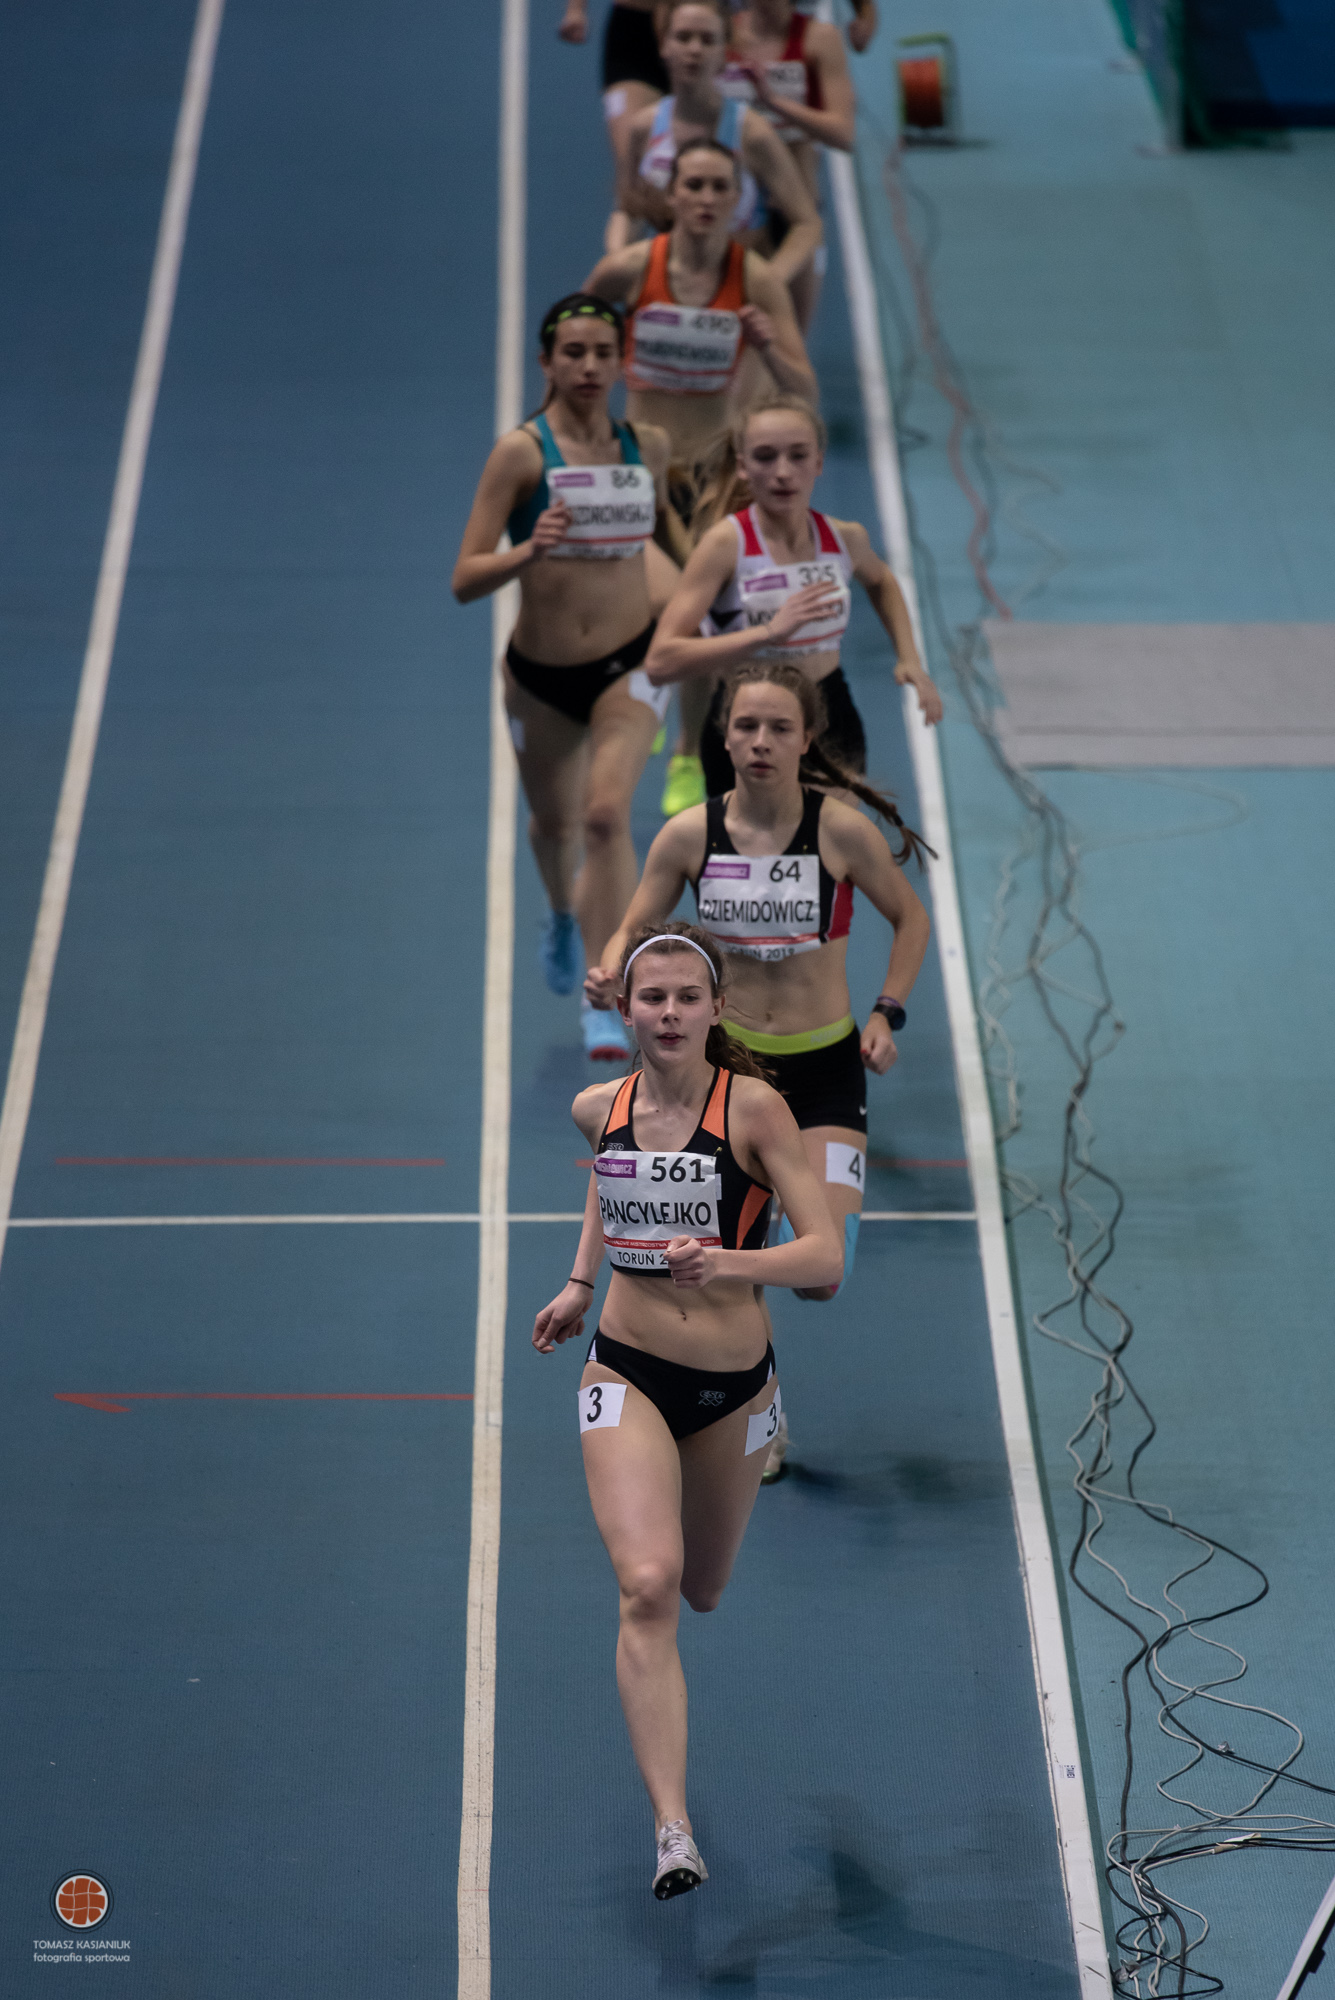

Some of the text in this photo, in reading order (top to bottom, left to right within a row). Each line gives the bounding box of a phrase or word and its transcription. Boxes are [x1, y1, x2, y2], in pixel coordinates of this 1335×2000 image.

[769, 861, 801, 883] 64
[702, 900, 814, 923] DZIEMIDOWICZ
[650, 1156, 706, 1183] 561
[848, 1151, 862, 1184] 4
[599, 1195, 711, 1227] PANCYLEJKO
[617, 1250, 655, 1265] TORUŃ
[586, 1386, 603, 1423] 3
[766, 1402, 778, 1437] 3
